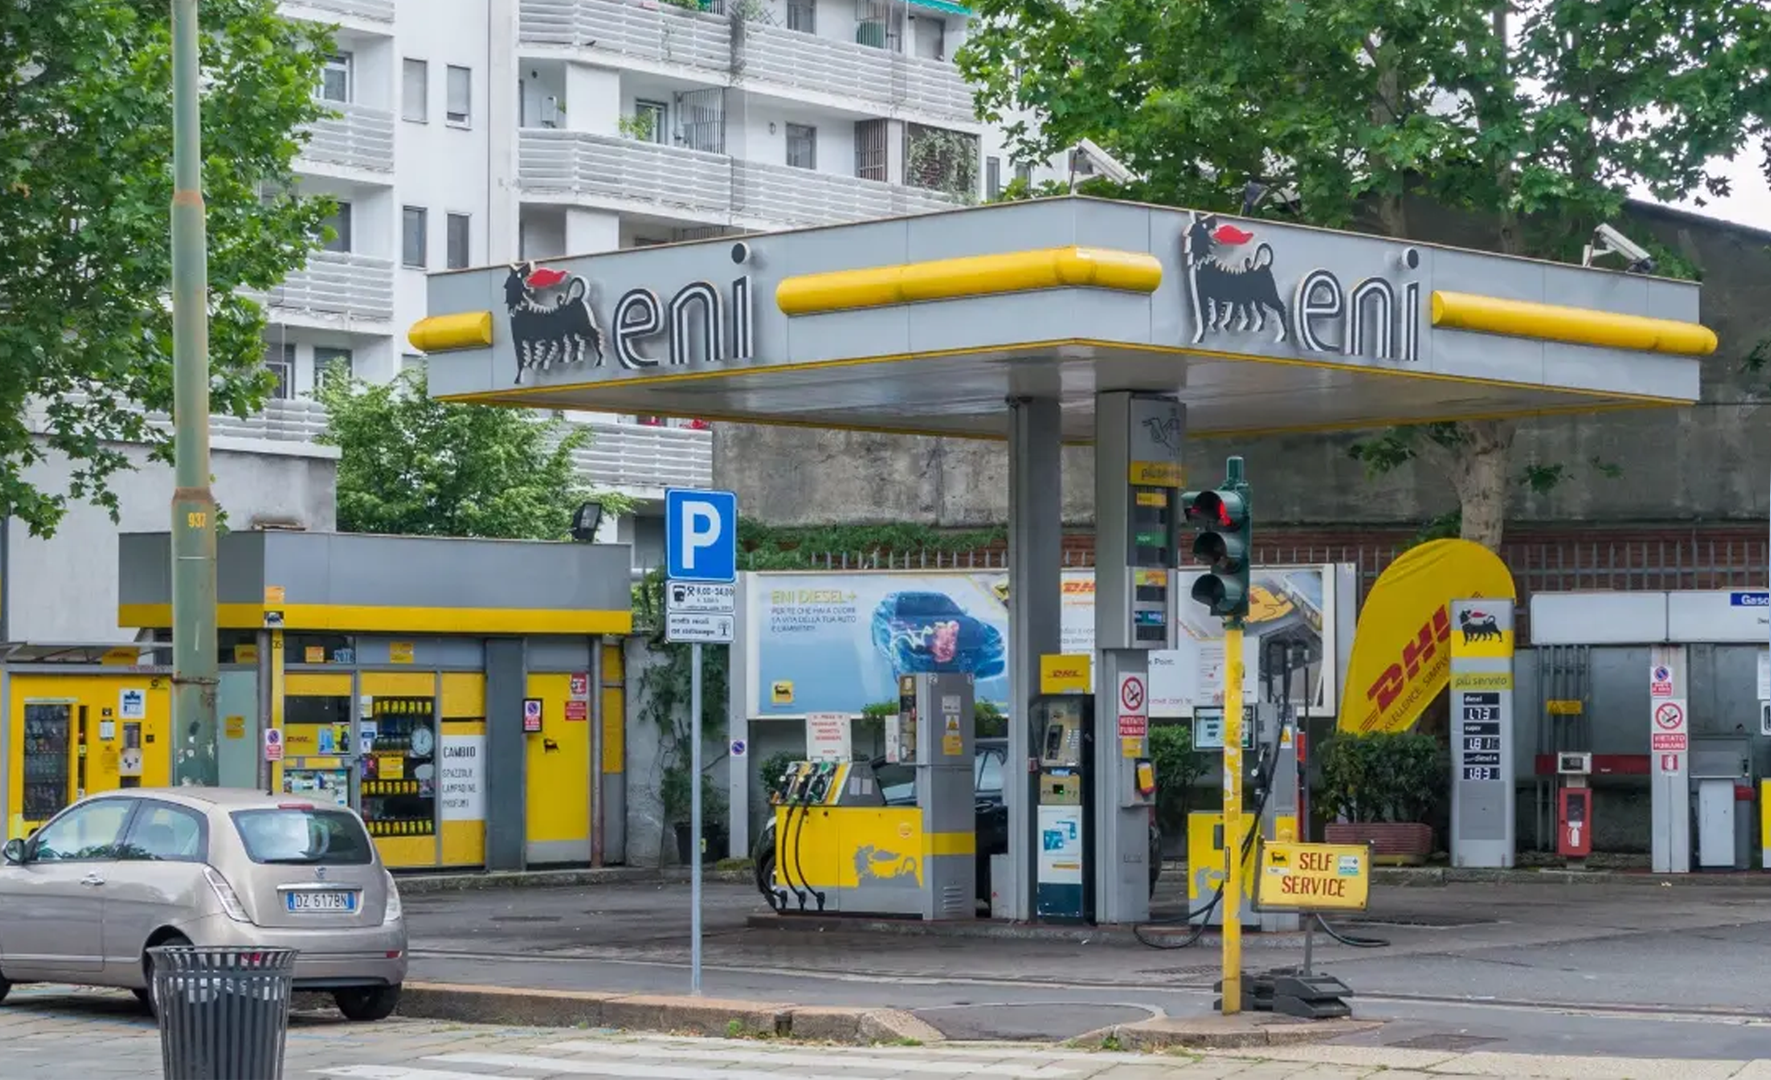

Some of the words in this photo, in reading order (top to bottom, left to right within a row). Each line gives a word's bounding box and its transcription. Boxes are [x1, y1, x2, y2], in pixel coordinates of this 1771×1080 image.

[612, 240, 753, 370] eni
[1294, 247, 1419, 361] eni
[682, 501, 721, 569] P
[771, 590, 795, 605] ENI
[1366, 604, 1450, 714] DHL
[443, 746, 476, 758] CAMBIO
[1299, 852, 1333, 872] SELF
[1281, 875, 1346, 897] SERVICE
